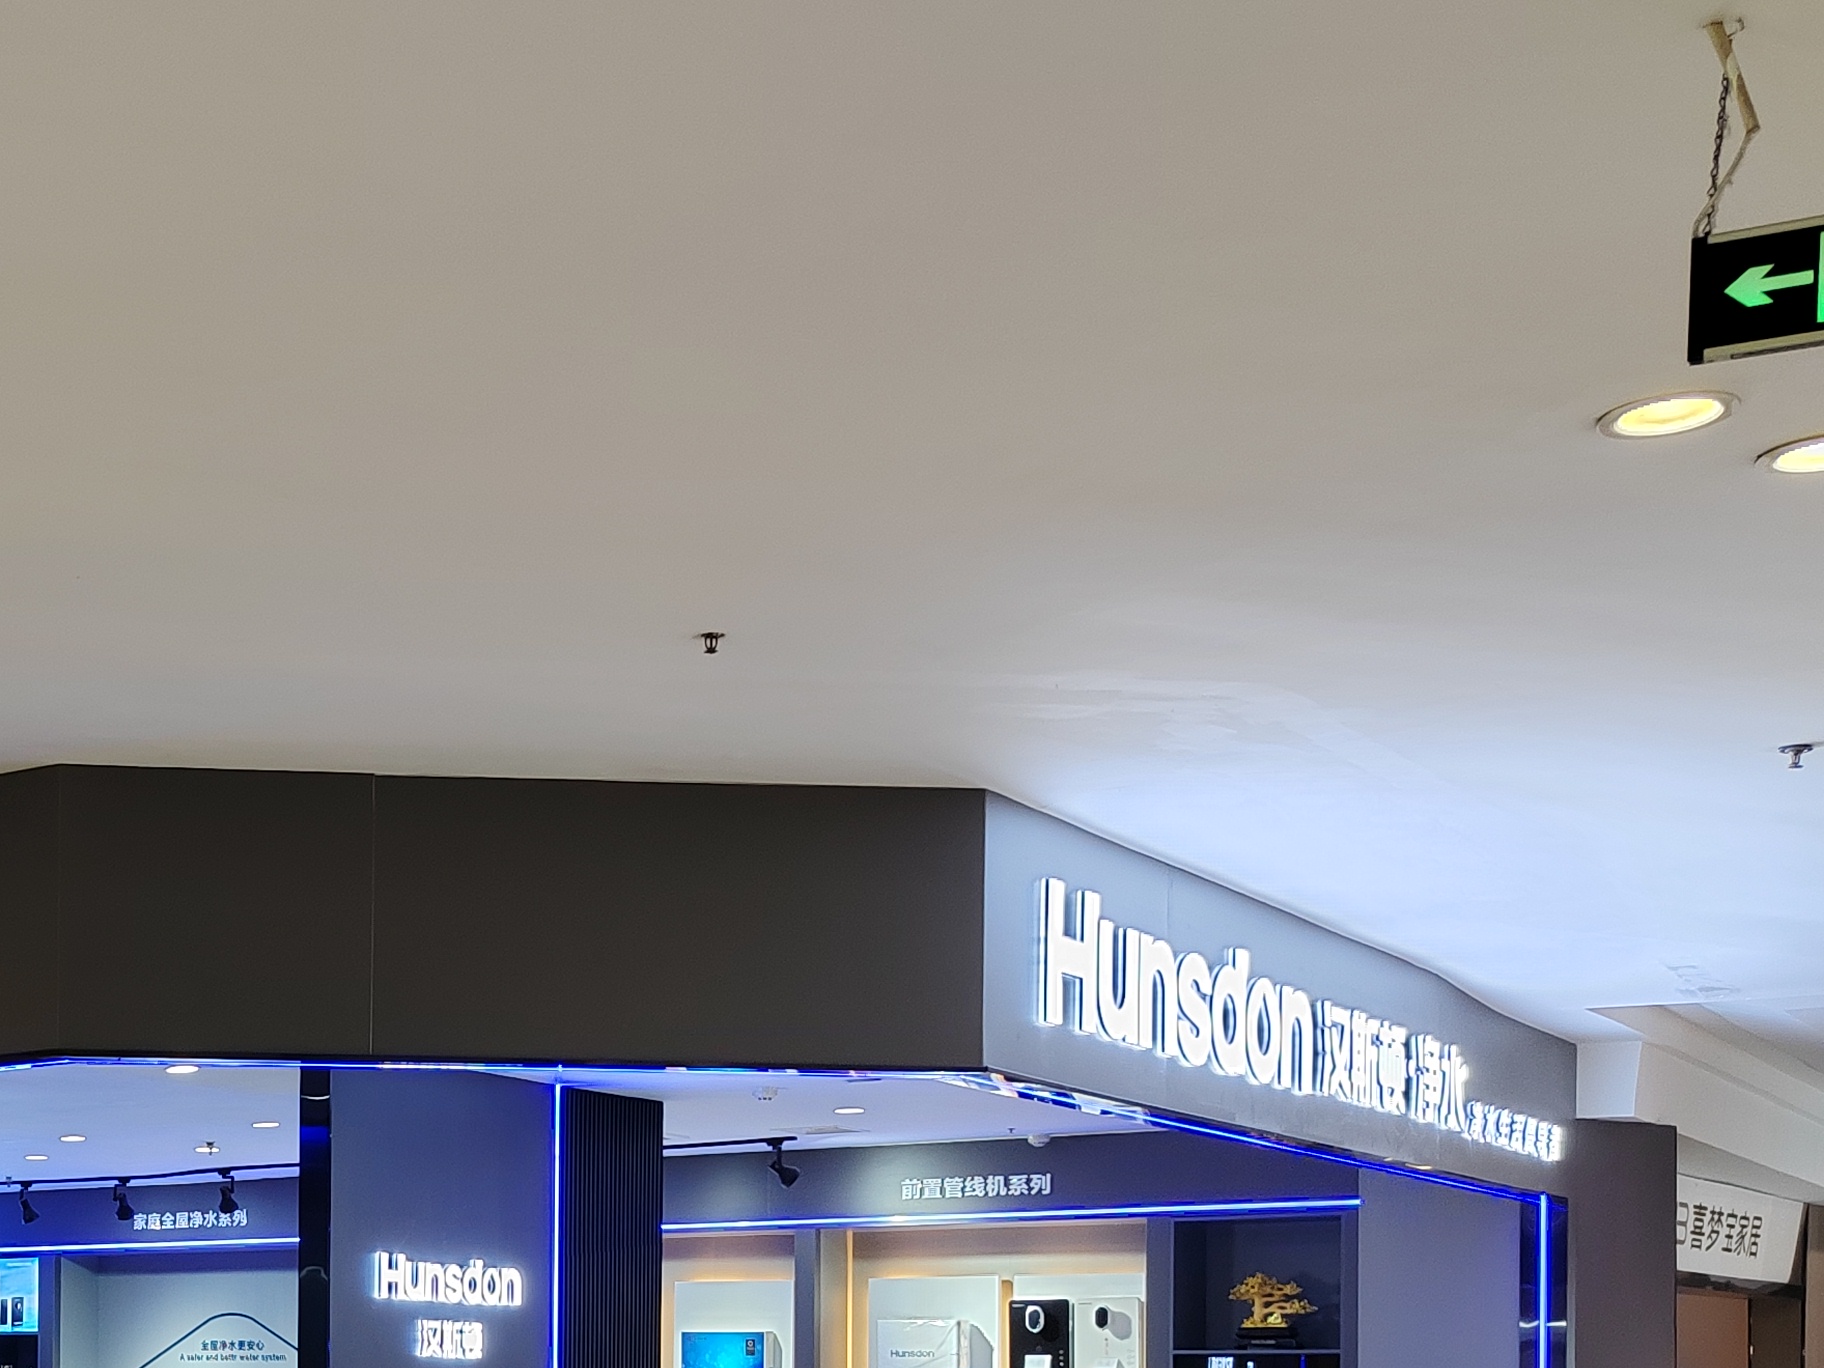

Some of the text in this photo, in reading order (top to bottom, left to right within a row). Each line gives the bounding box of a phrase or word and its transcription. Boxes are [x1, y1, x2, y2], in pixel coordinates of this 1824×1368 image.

[1036, 877, 1314, 1096] Hunsdon
[900, 1173, 1052, 1201] 前置管线机系列
[133, 1209, 248, 1231] 家庭全屋净水系列
[1690, 1202, 1763, 1259] 喜梦宝家居
[375, 1251, 523, 1306] Hunsdon
[890, 1349, 935, 1358] Hunsdon
